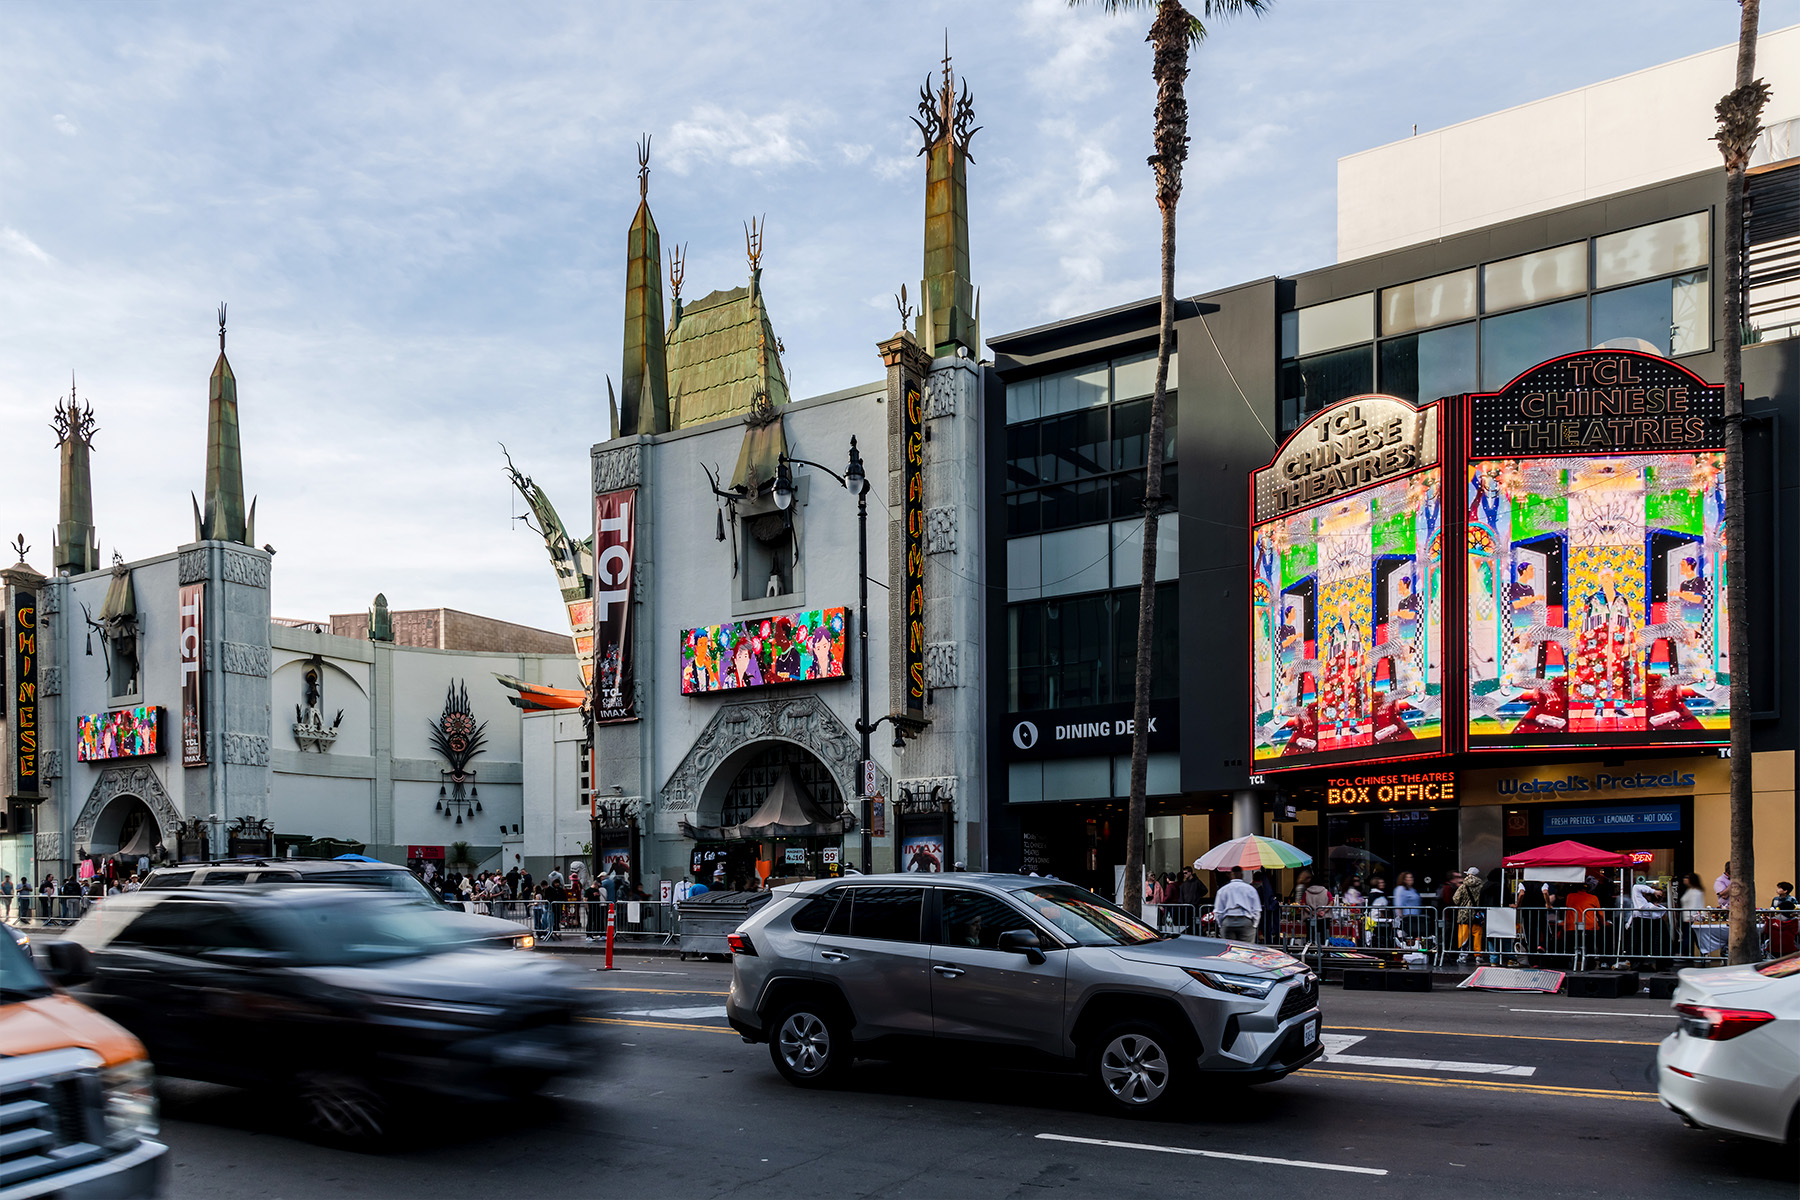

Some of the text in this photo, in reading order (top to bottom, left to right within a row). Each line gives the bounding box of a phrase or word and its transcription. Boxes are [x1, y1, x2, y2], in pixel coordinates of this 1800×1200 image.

[1568, 359, 1640, 386] TCL
[1521, 387, 1687, 418] CHINESE
[1313, 406, 1366, 442] TCL
[1504, 417, 1705, 449] THEATRES
[1282, 417, 1402, 481] CHINESE
[1272, 444, 1416, 511] THEATRES
[599, 502, 630, 621] TCL
[181, 593, 199, 687] TCL
[18, 607, 36, 777] CHINESE
[602, 688, 622, 697] TCL
[600, 708, 627, 718] IMAX
[1055, 717, 1157, 740] DINING DEK
[184, 755, 201, 763] IMAX
[1249, 775, 1265, 785] TCL
[1328, 772, 1455, 787] TCL CHINESE THEATRES
[1498, 770, 1696, 795] Wetzel's Pretzels
[1328, 783, 1455, 805] BOX OFFICE
[1551, 812, 1673, 825] FRESH PRETZELS LEMONADE HOT DOGS
[904, 843, 943, 855] IMAX
